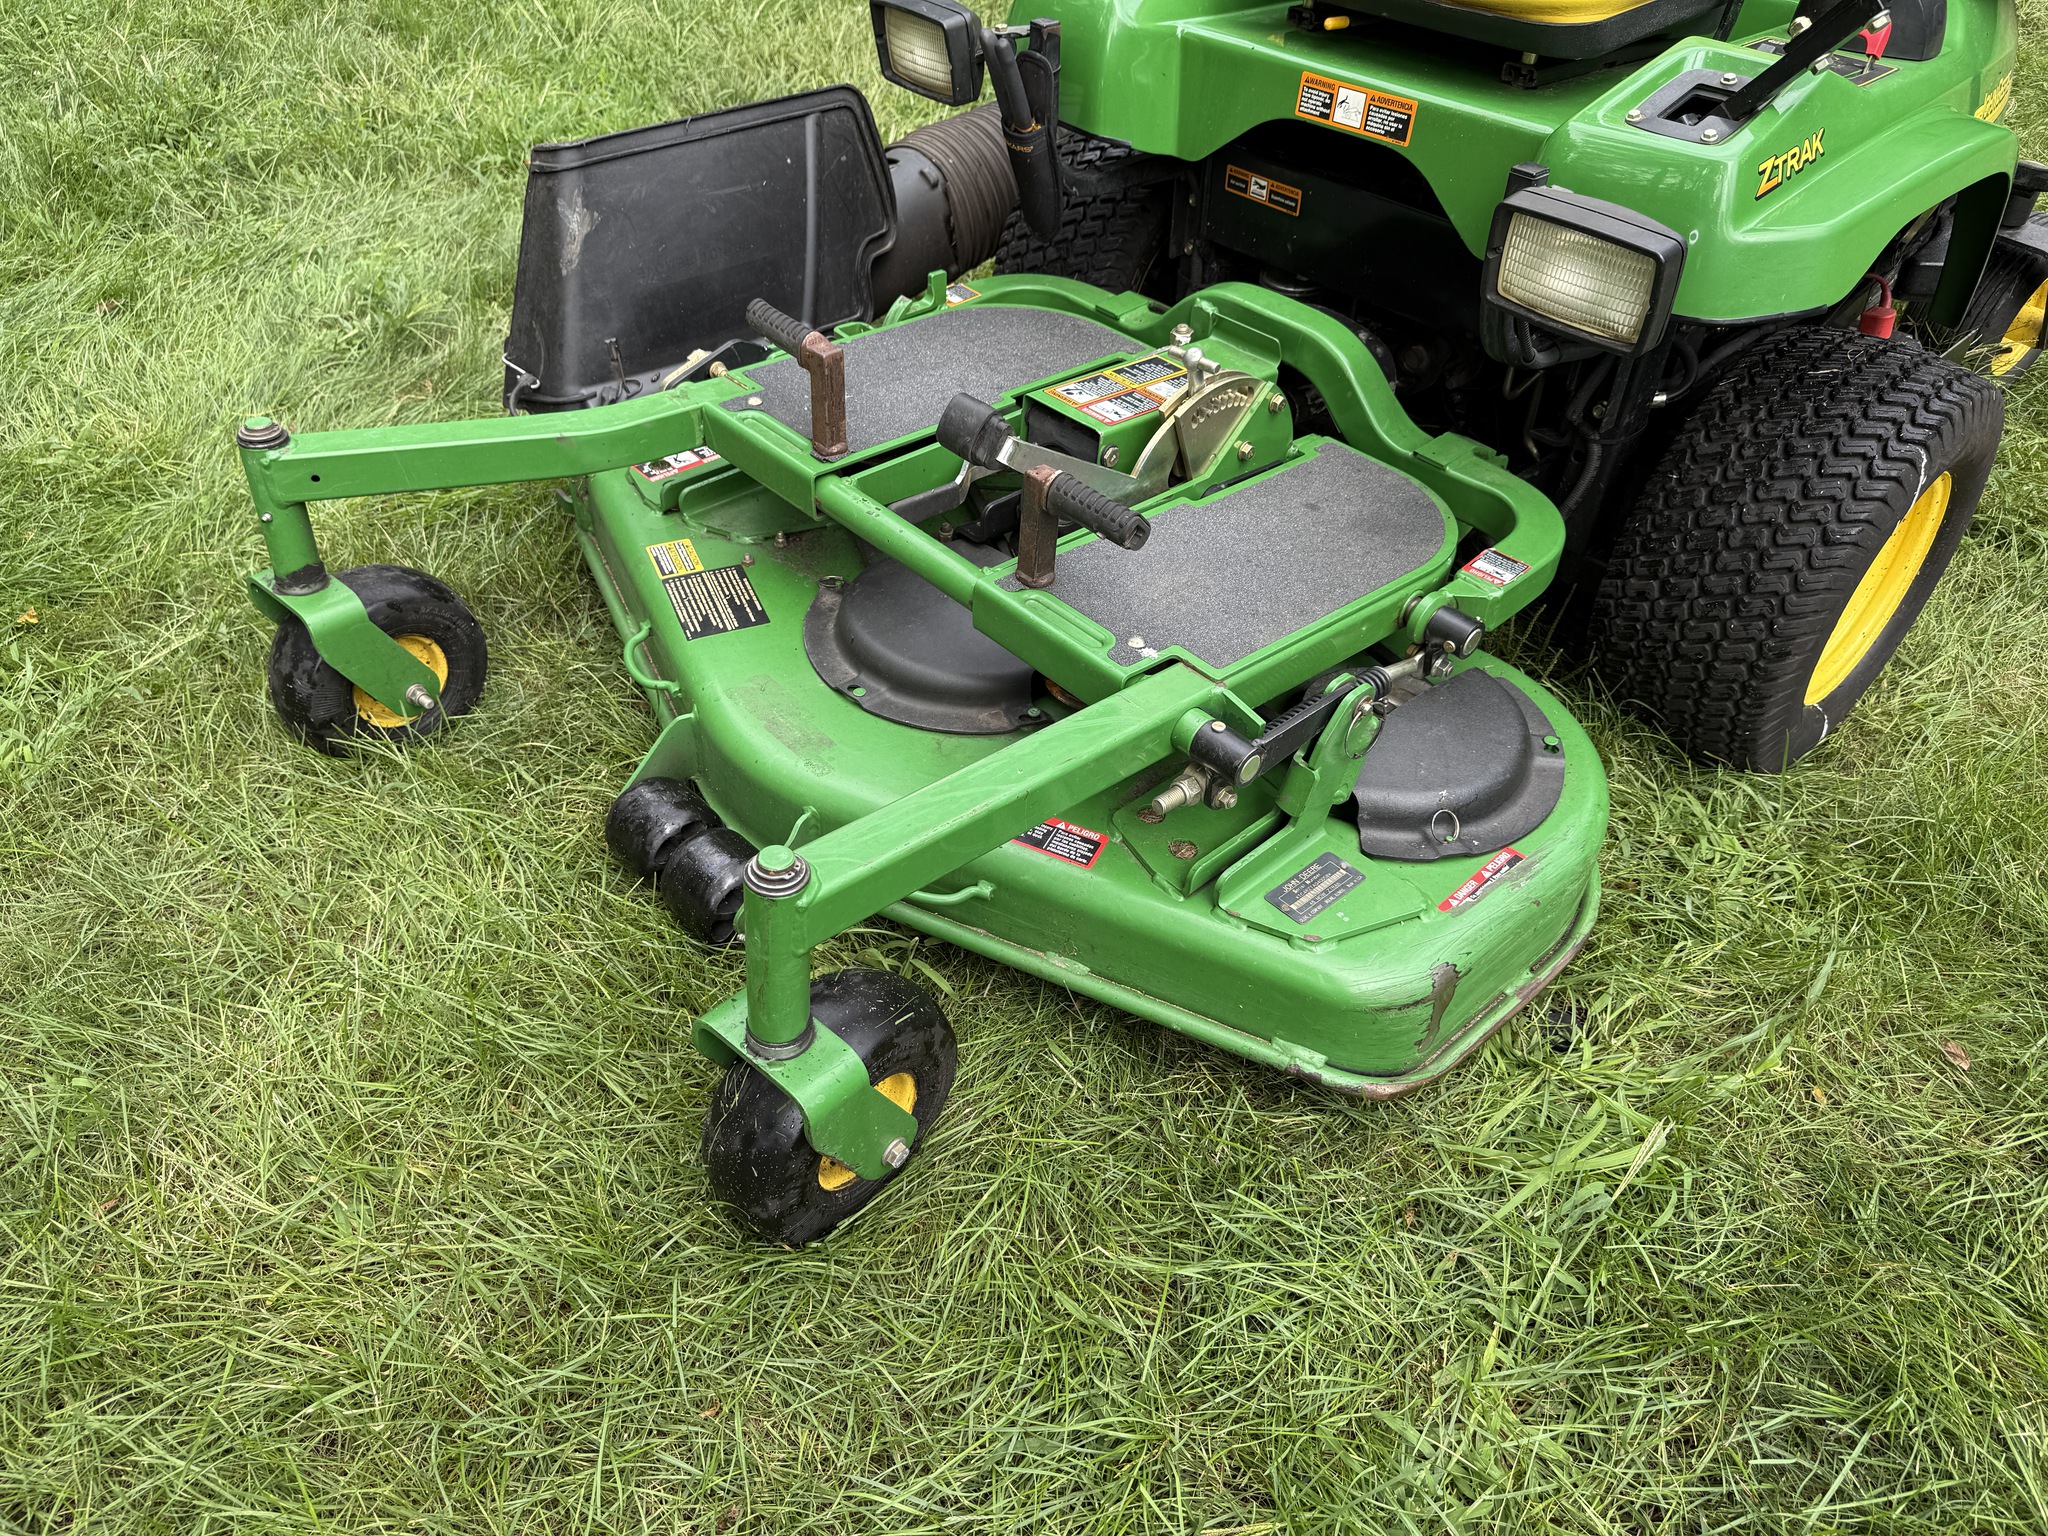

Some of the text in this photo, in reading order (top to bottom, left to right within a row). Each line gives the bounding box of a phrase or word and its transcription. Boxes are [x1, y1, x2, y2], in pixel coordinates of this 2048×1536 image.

[1310, 77, 1335, 90] WARNING
[1377, 96, 1412, 111] ADVERTENCIA
[1391, 111, 1407, 119] lesiones
[1755, 127, 1825, 201] ZTRAK
[1069, 824, 1101, 840] PELIGRO
[1486, 852, 1510, 871] PELIGRO
[1282, 878, 1301, 892] JOHN
[1298, 863, 1323, 880] DEERE
[1290, 873, 1320, 893] Serial Number
[1453, 880, 1478, 899] DANGER
